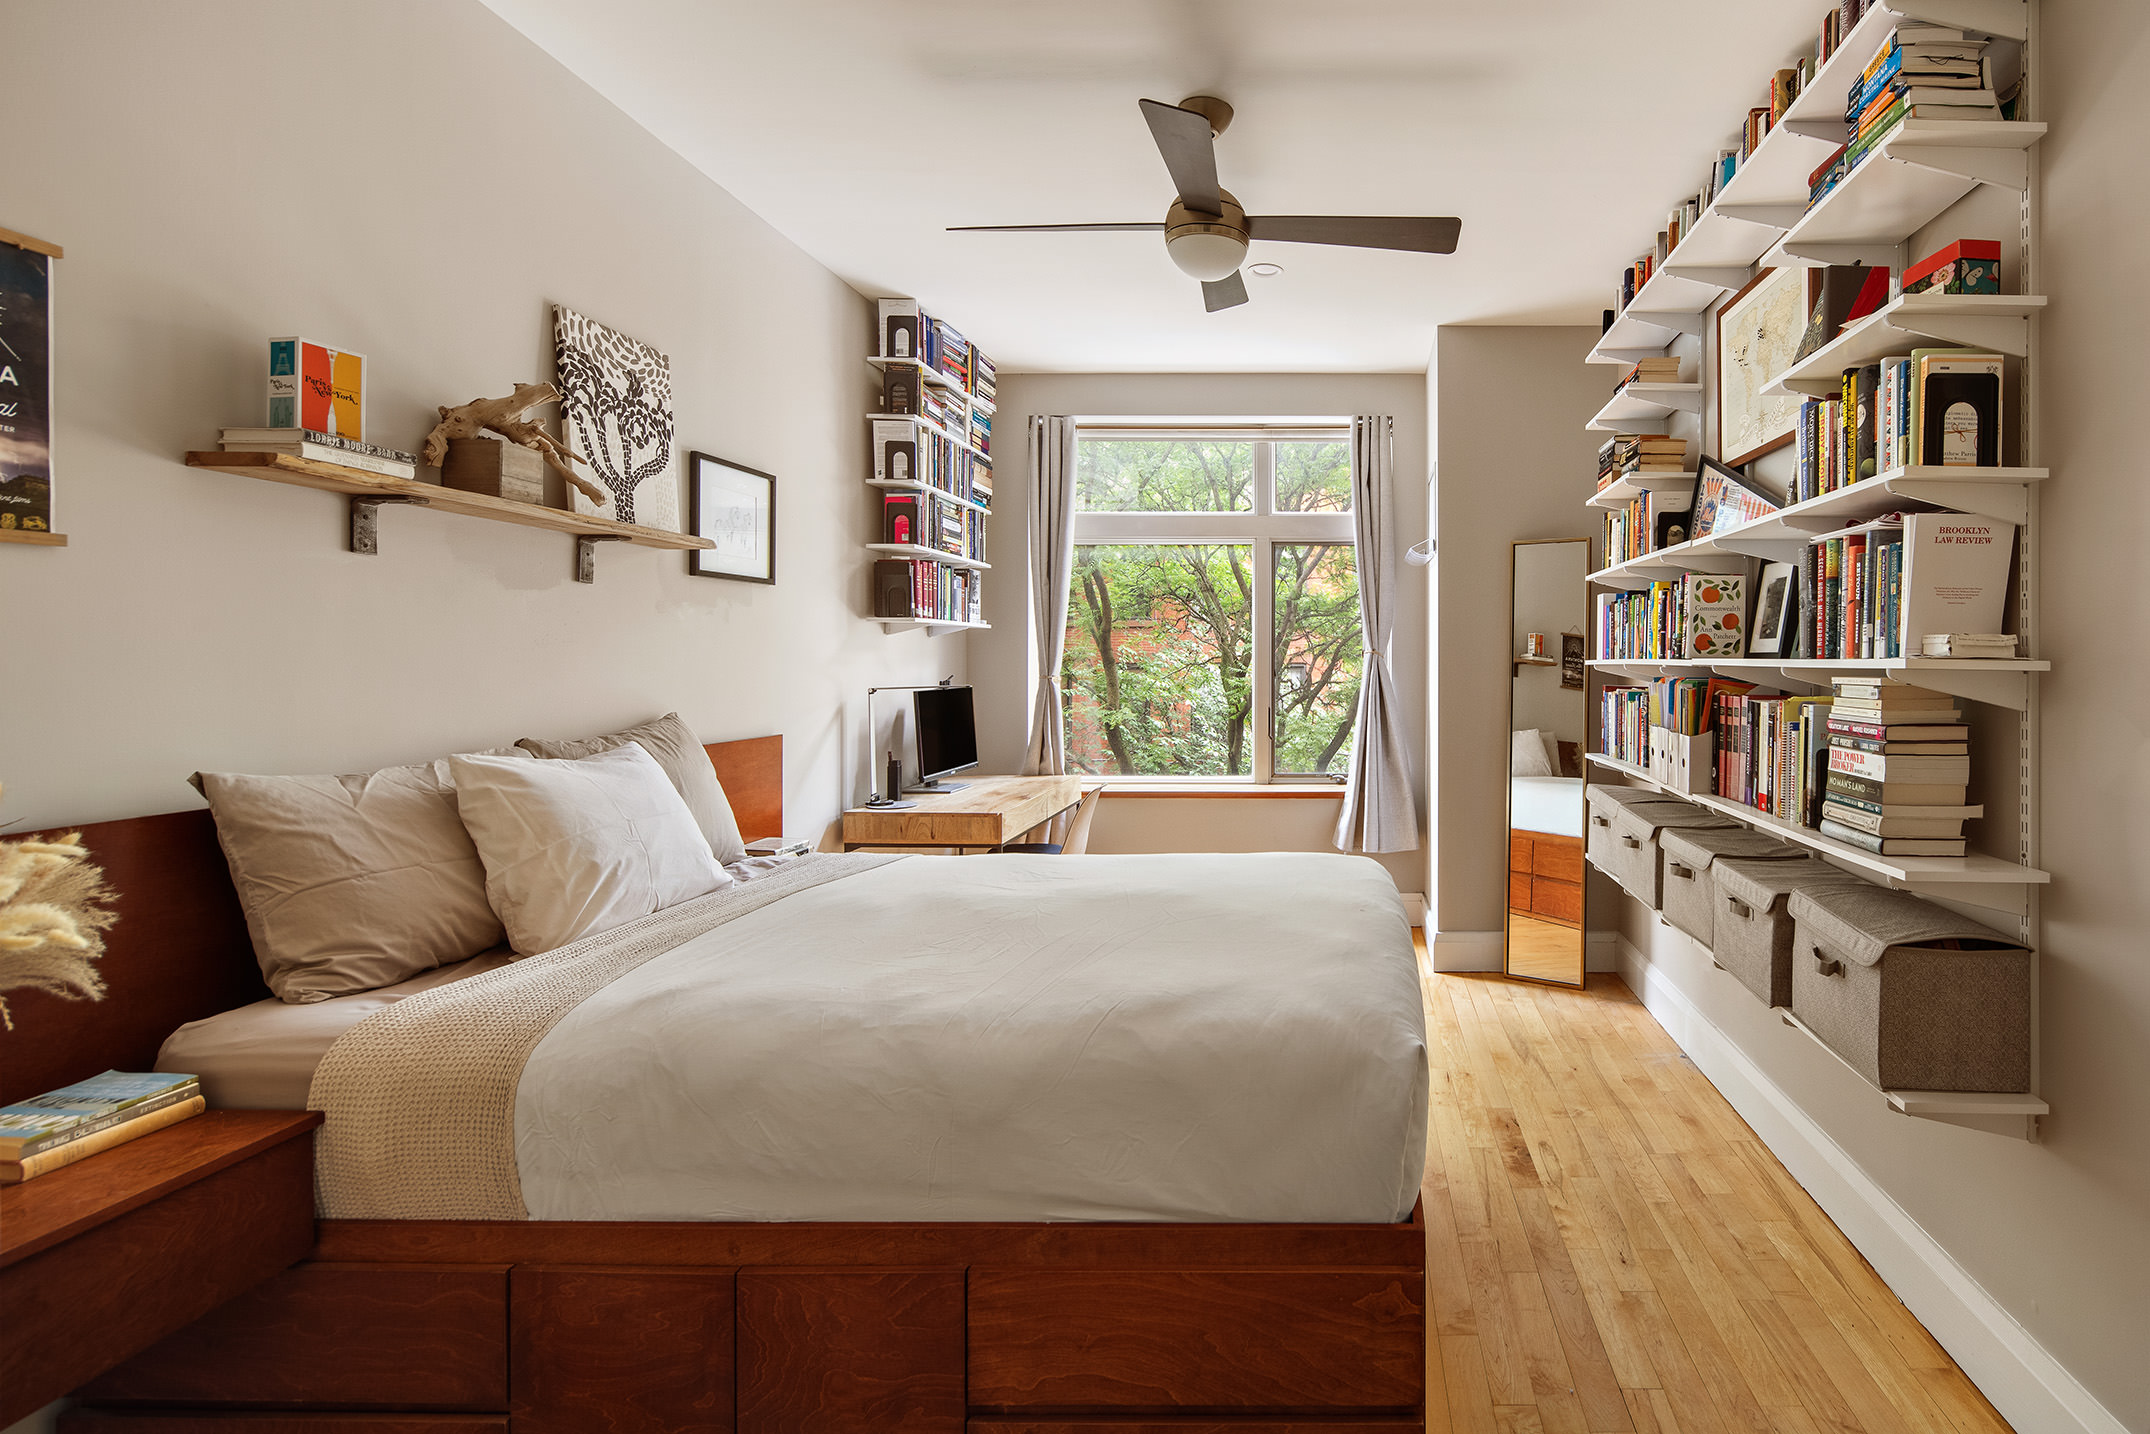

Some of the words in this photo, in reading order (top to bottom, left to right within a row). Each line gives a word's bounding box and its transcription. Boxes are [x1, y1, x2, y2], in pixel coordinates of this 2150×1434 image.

[1862, 63, 1888, 94] MONTANA
[305, 375, 326, 386] Paris
[333, 391, 358, 405] York
[310, 432, 340, 447] LORRIE
[343, 440, 371, 454] MOORE
[1939, 526, 1991, 535] BROOKLYN
[1934, 536, 1954, 544] LAW
[1955, 536, 1993, 545] REVIEW
[1831, 749, 1842, 759] THE
[1844, 751, 1865, 764] POWER
[1831, 760, 1855, 772] BROKER
[1829, 777, 1836, 785] NO
[1837, 779, 1852, 790] MAN'S
[1852, 783, 1866, 793] LAND
